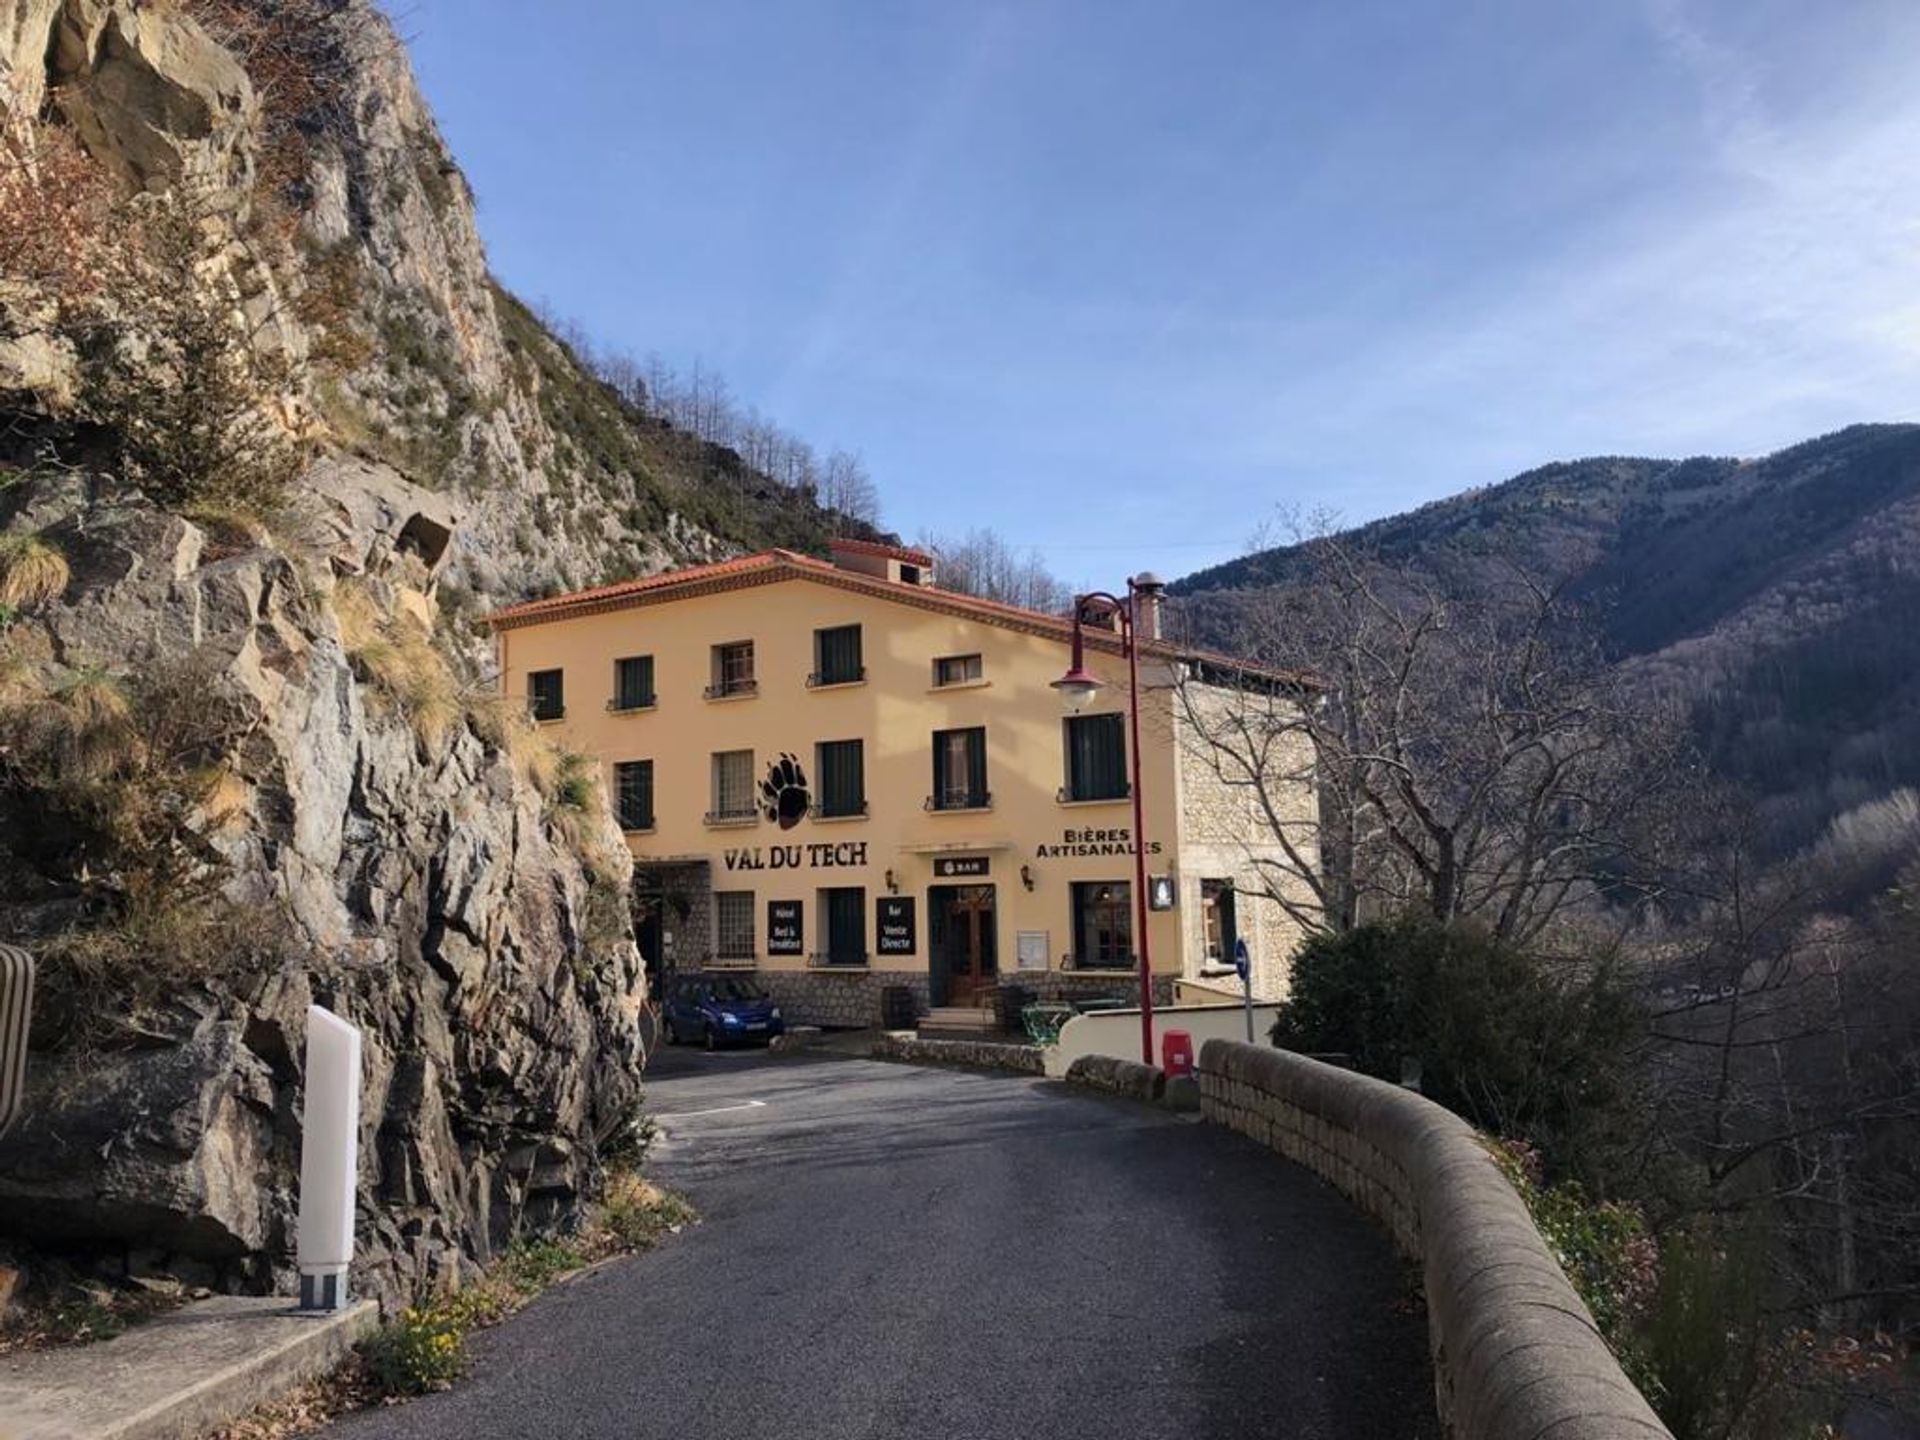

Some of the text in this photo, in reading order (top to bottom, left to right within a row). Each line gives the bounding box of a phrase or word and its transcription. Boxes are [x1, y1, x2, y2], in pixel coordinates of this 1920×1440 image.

[1064, 825, 1130, 843] BIÈRES
[724, 842, 867, 871] VAL DU TECH
[957, 863, 980, 872] BAR
